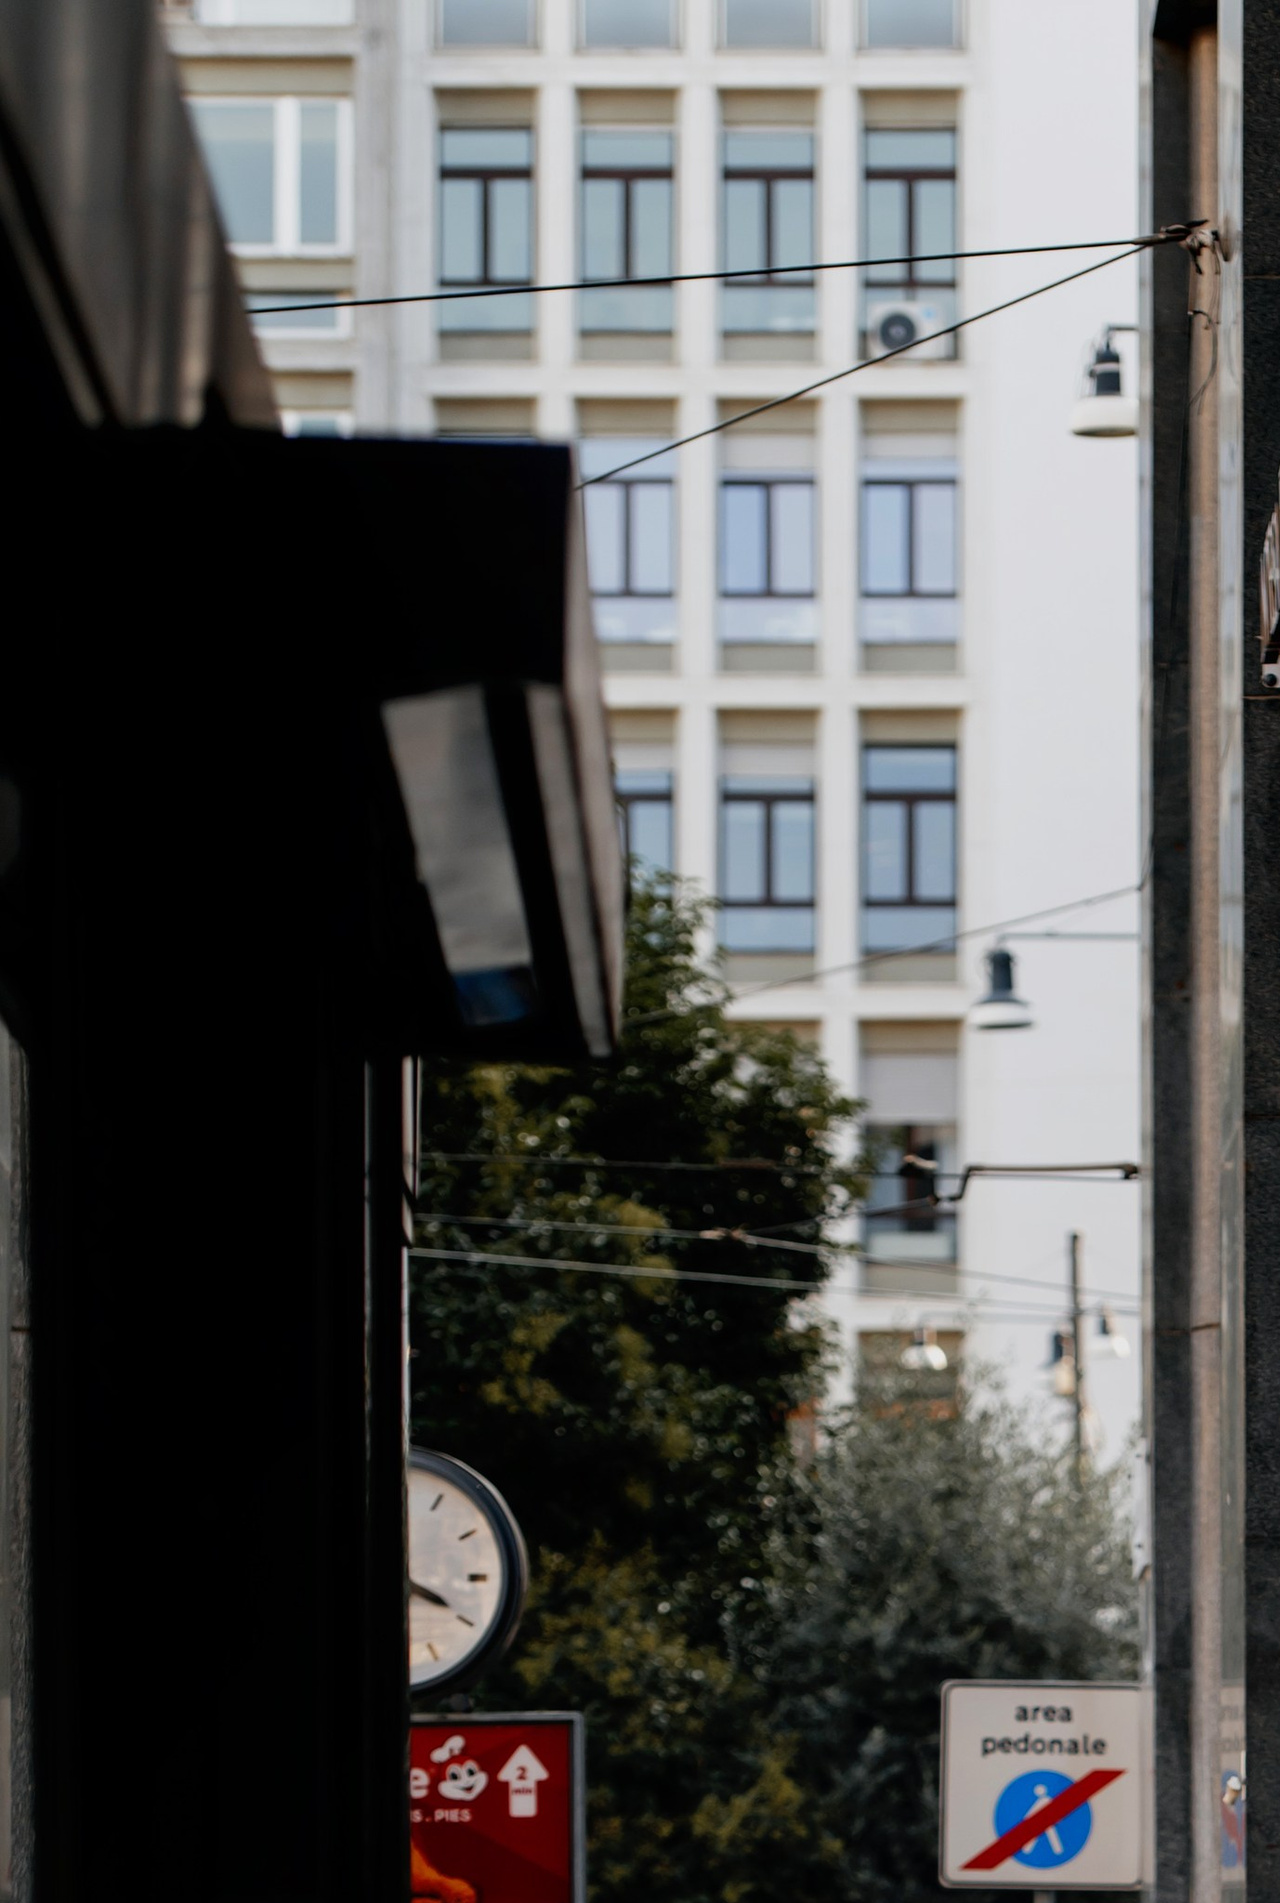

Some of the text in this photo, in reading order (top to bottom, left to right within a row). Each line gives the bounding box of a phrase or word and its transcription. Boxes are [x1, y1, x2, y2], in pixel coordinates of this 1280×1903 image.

[1015, 1705, 1073, 1722] area
[982, 1732, 1107, 1758] pedonale
[516, 1765, 527, 1781] 2
[433, 1807, 473, 1823] PIES
